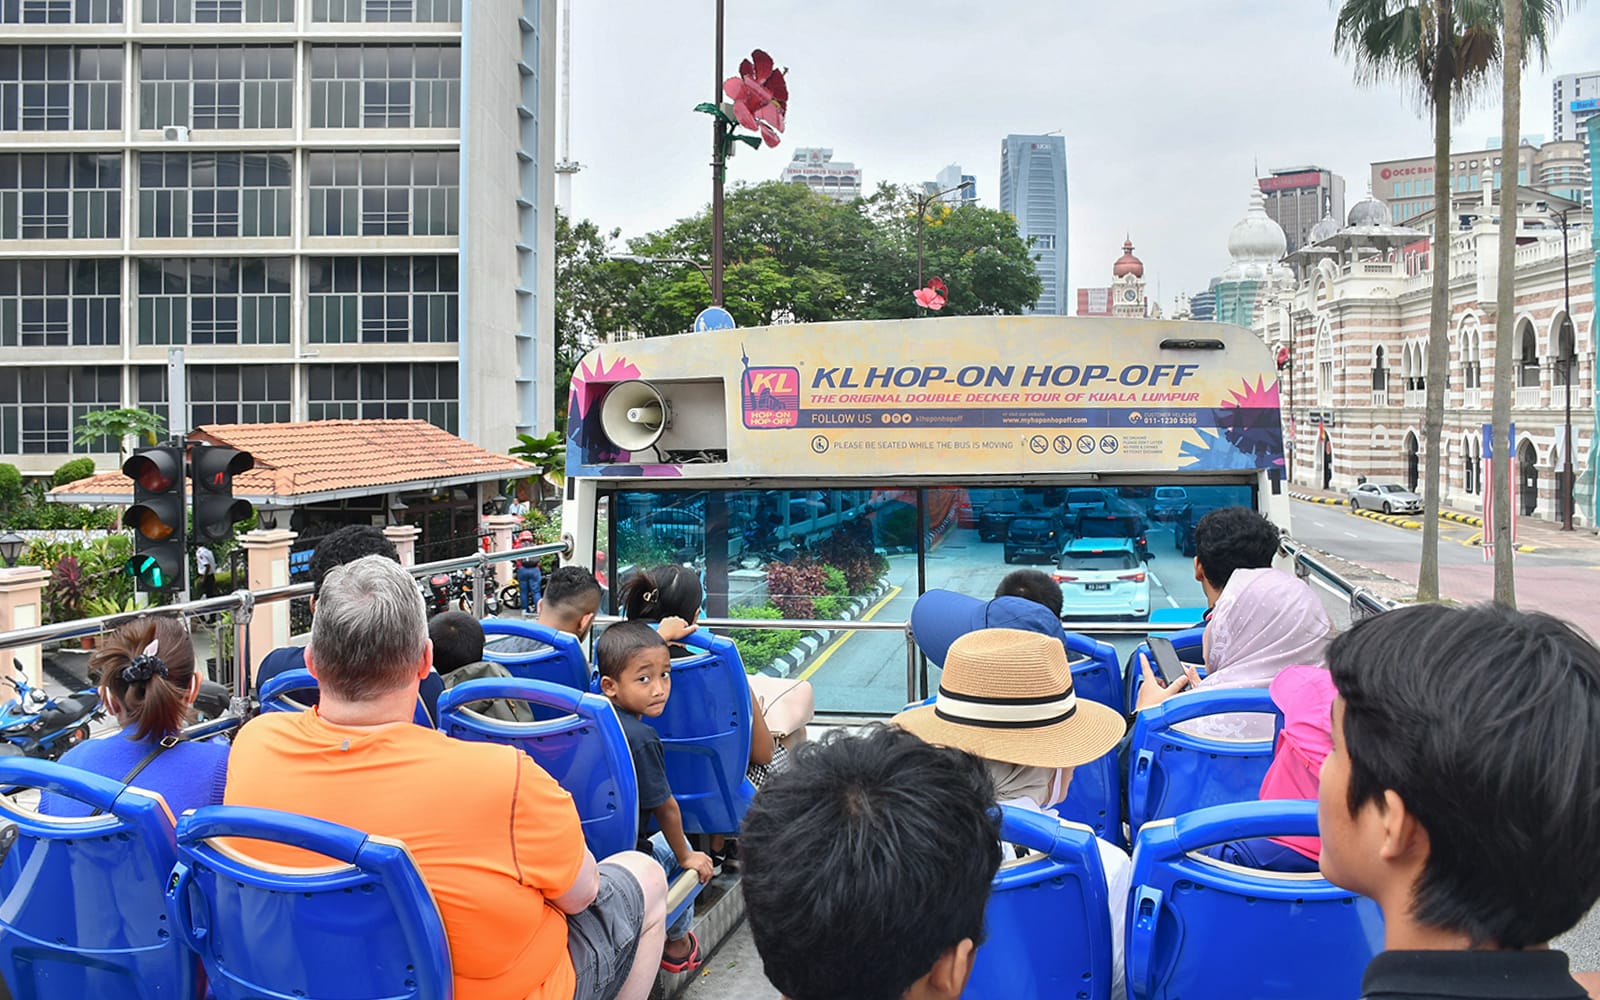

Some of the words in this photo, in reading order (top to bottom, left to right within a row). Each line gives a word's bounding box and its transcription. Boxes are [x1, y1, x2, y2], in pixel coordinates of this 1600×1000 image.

[1393, 168, 1416, 176] OCBC
[811, 367, 859, 388] KL
[864, 366, 1016, 388] HOP-ON
[1020, 364, 1200, 387] HOP-OFF
[751, 373, 793, 393] KL
[811, 394, 836, 403] THE
[838, 394, 902, 403] ORIGINAL
[905, 393, 961, 403] DOUBLE
[965, 393, 1020, 402] DECKER
[1024, 393, 1062, 402] TOUR
[1064, 393, 1085, 402] OF
[1088, 392, 1137, 402] KUALA
[1141, 392, 1200, 402] LUMPUR
[811, 413, 854, 424] FOLLOW
[858, 413, 872, 424] US
[1002, 416, 1088, 424] www.myhoponhopoff.com
[834, 441, 863, 449] PLEASE
[865, 441, 876, 449] BE
[878, 441, 908, 449] SEATED
[910, 441, 934, 449] WHILE
[937, 441, 950, 449] THE
[954, 441, 970, 449] BUS
[972, 441, 980, 449] IS
[982, 441, 1014, 449] MOVING
